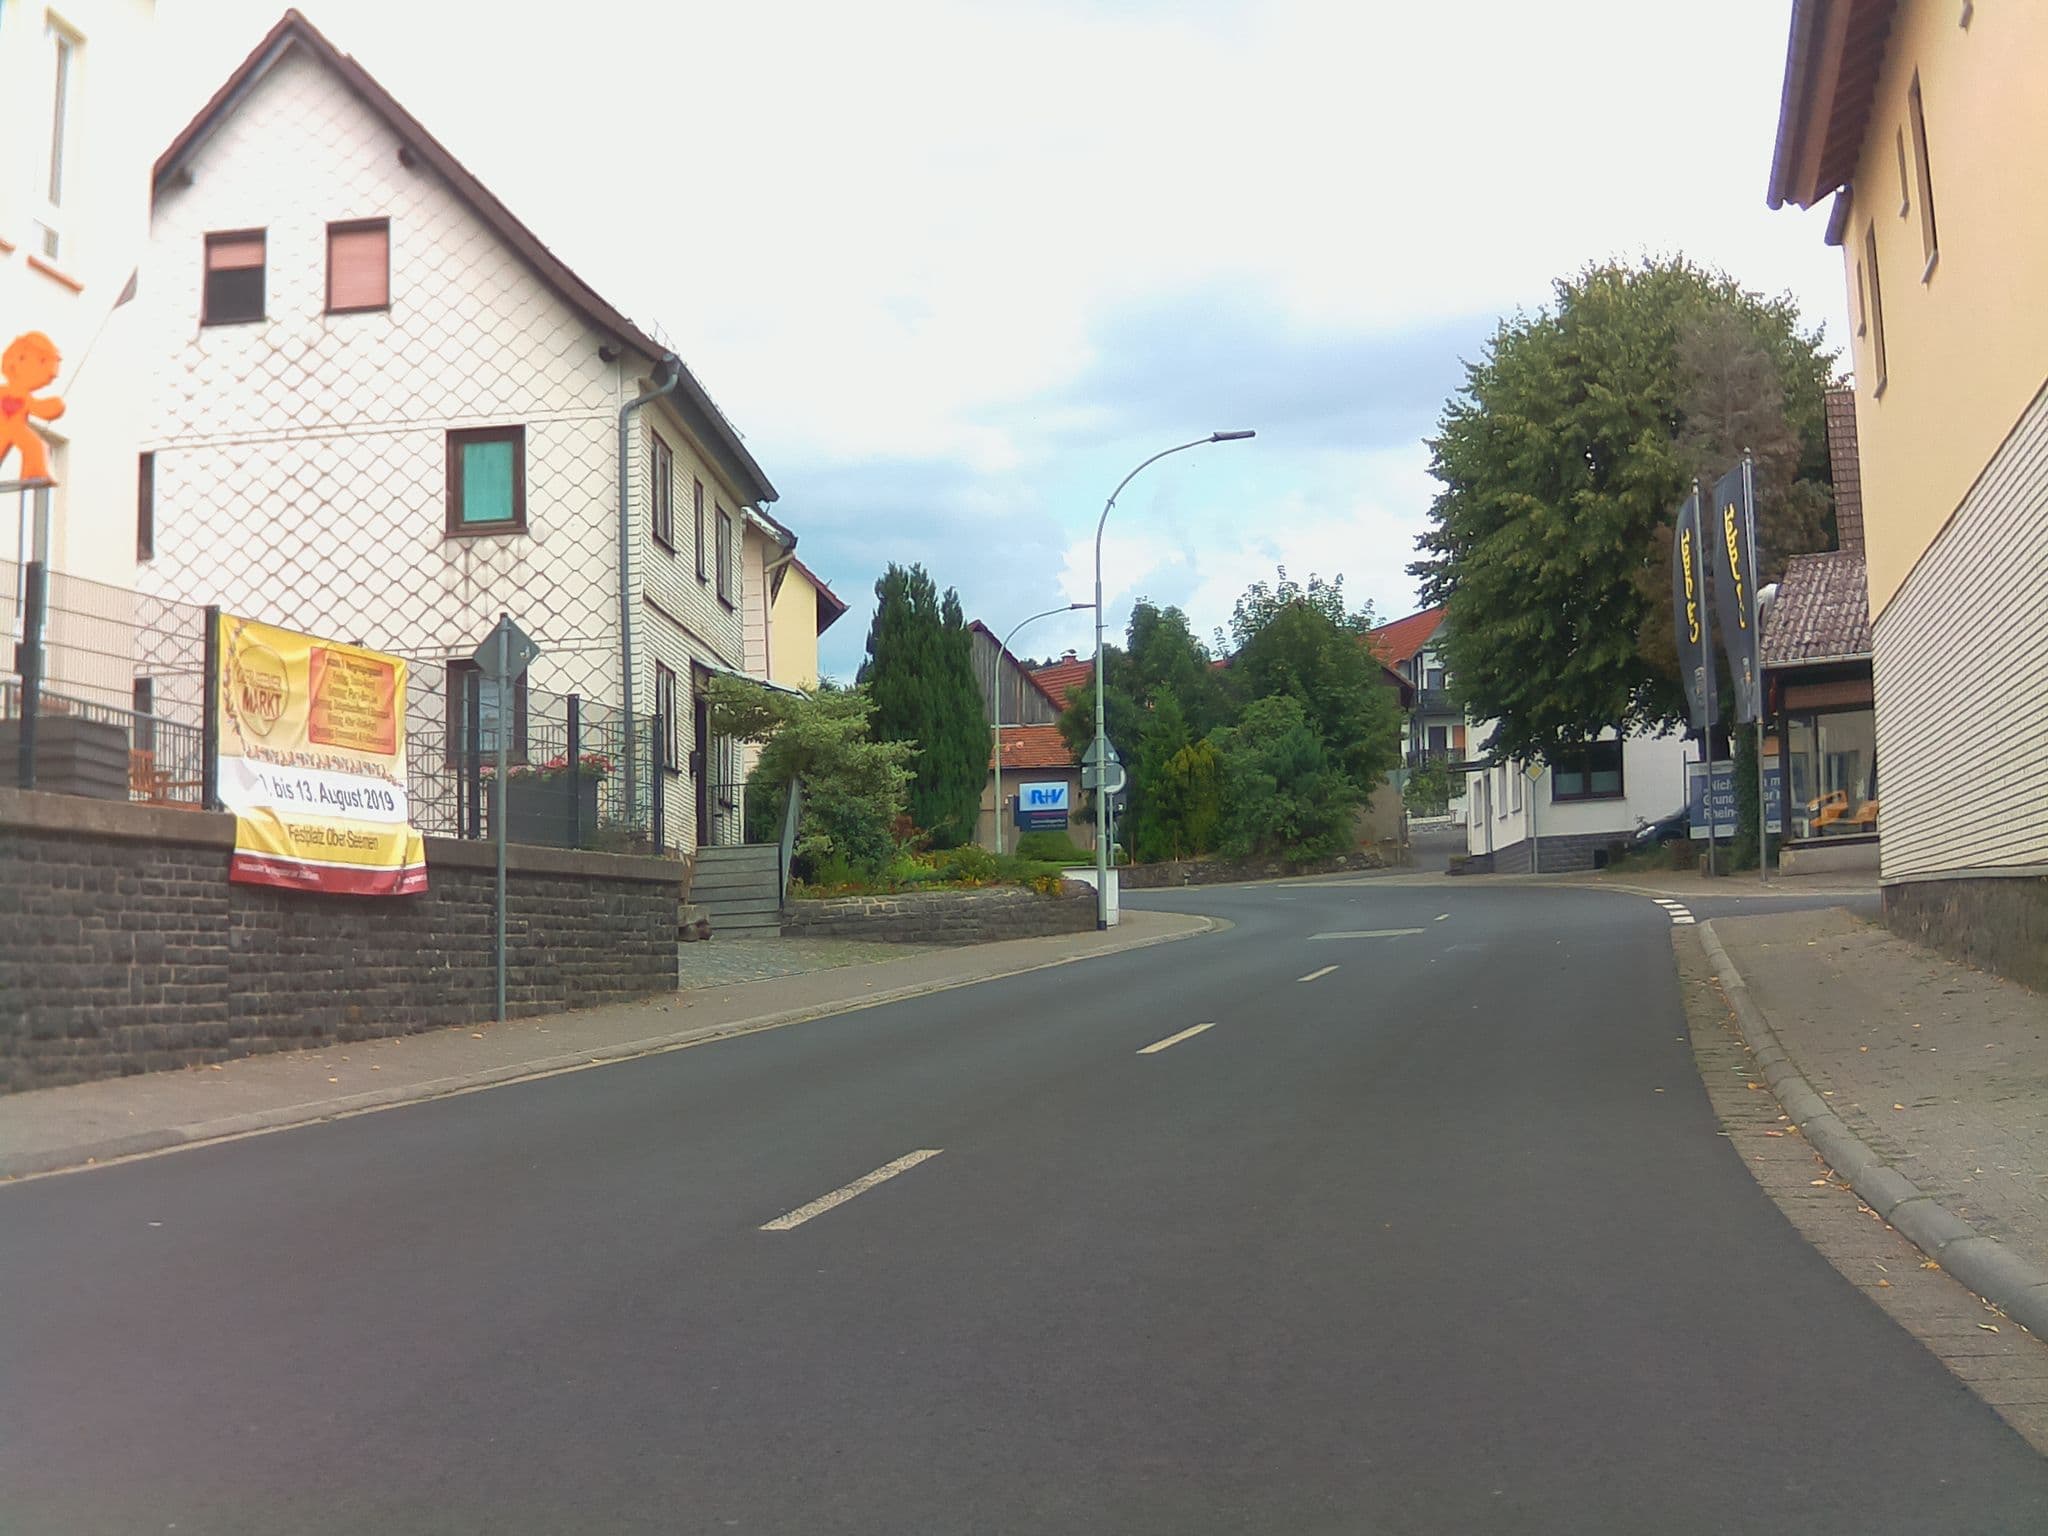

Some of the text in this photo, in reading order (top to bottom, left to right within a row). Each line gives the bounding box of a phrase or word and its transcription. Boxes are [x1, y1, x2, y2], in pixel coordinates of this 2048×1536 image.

[272, 776, 294, 800] bis
[296, 779, 317, 802] 13.
[320, 782, 364, 811] August
[364, 788, 394, 811] 2019
[1031, 788, 1064, 805] R+V
[288, 824, 325, 847] Festplatz
